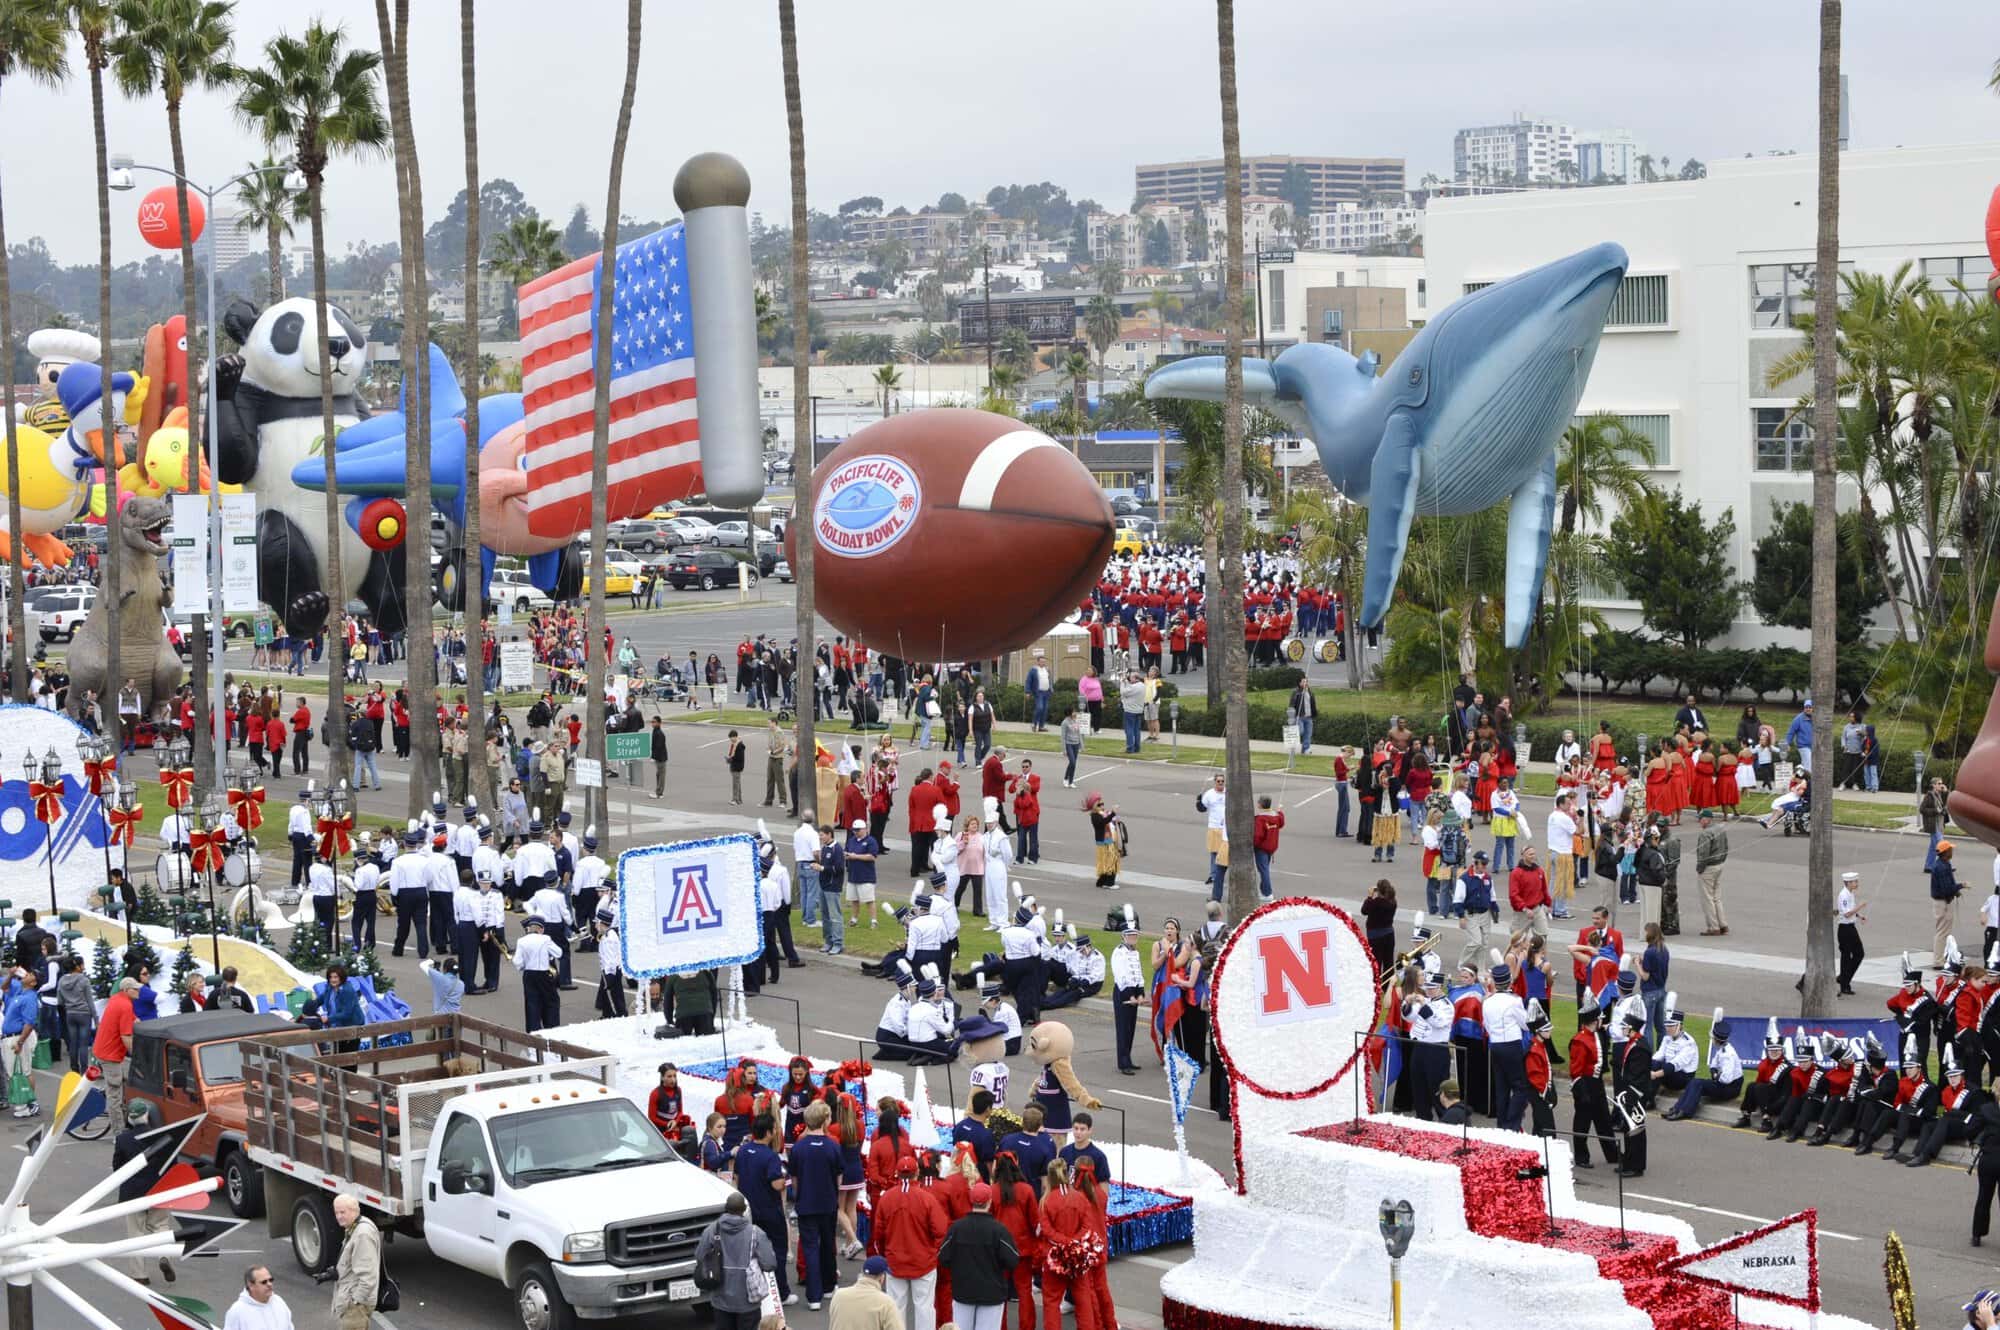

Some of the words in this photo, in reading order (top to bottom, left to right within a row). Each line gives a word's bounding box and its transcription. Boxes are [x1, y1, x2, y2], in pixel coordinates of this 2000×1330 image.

[830, 463, 879, 493] PACIFIC
[875, 462, 905, 490] LIFE
[819, 517, 864, 549] HOLIDAY
[865, 514, 905, 547] BOWL
[616, 737, 640, 748] Grape
[616, 747, 641, 757] Street
[662, 864, 722, 934] A
[1256, 926, 1333, 1016] N
[1743, 1255, 1796, 1268] NEBRASKA
